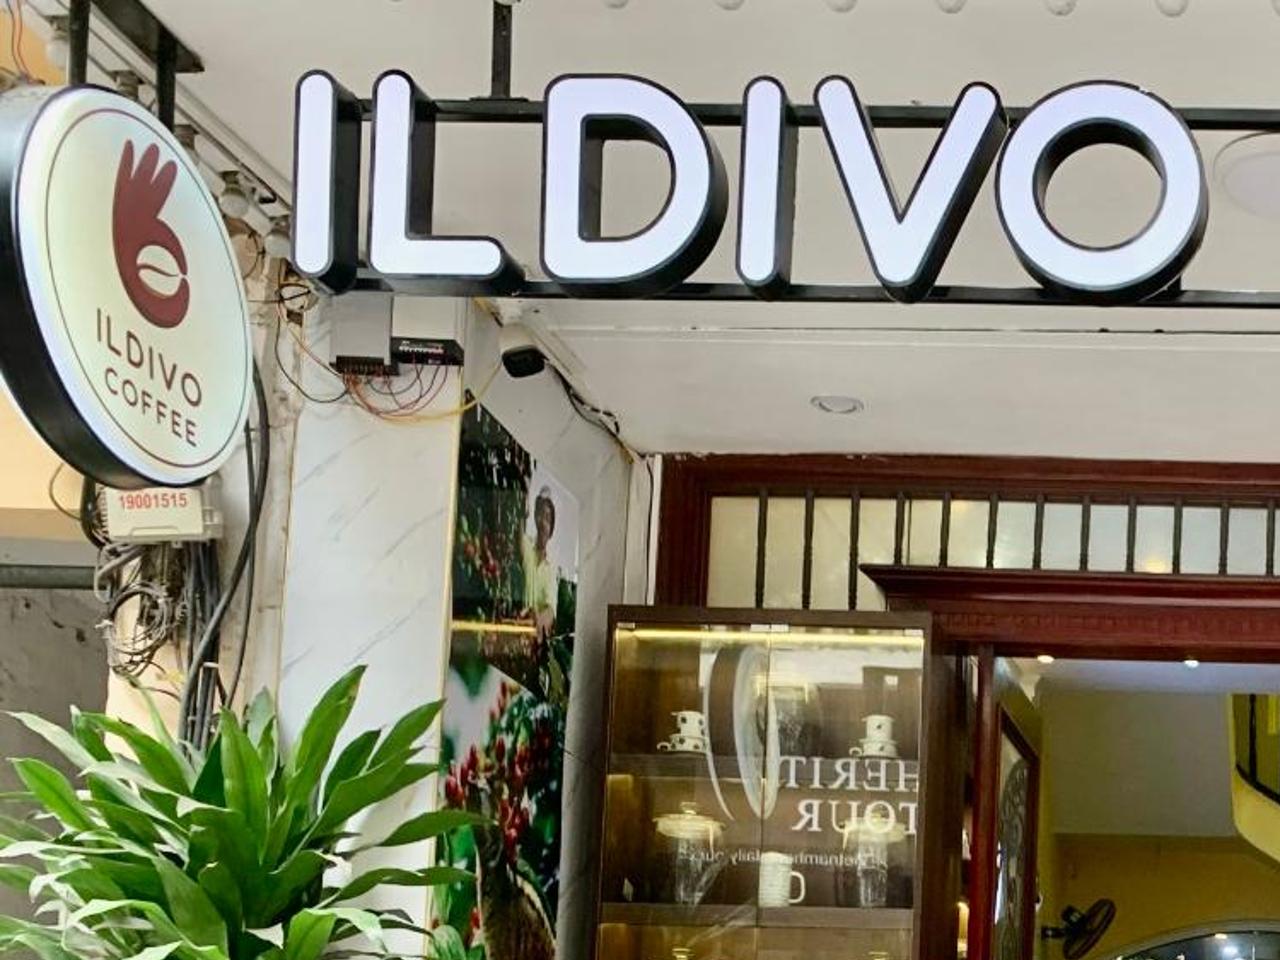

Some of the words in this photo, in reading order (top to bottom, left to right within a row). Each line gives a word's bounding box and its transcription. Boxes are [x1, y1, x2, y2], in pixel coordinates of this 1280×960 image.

[97, 307, 202, 407] ILDIVO
[104, 367, 197, 447] COFFEE
[118, 493, 188, 510] 19001515
